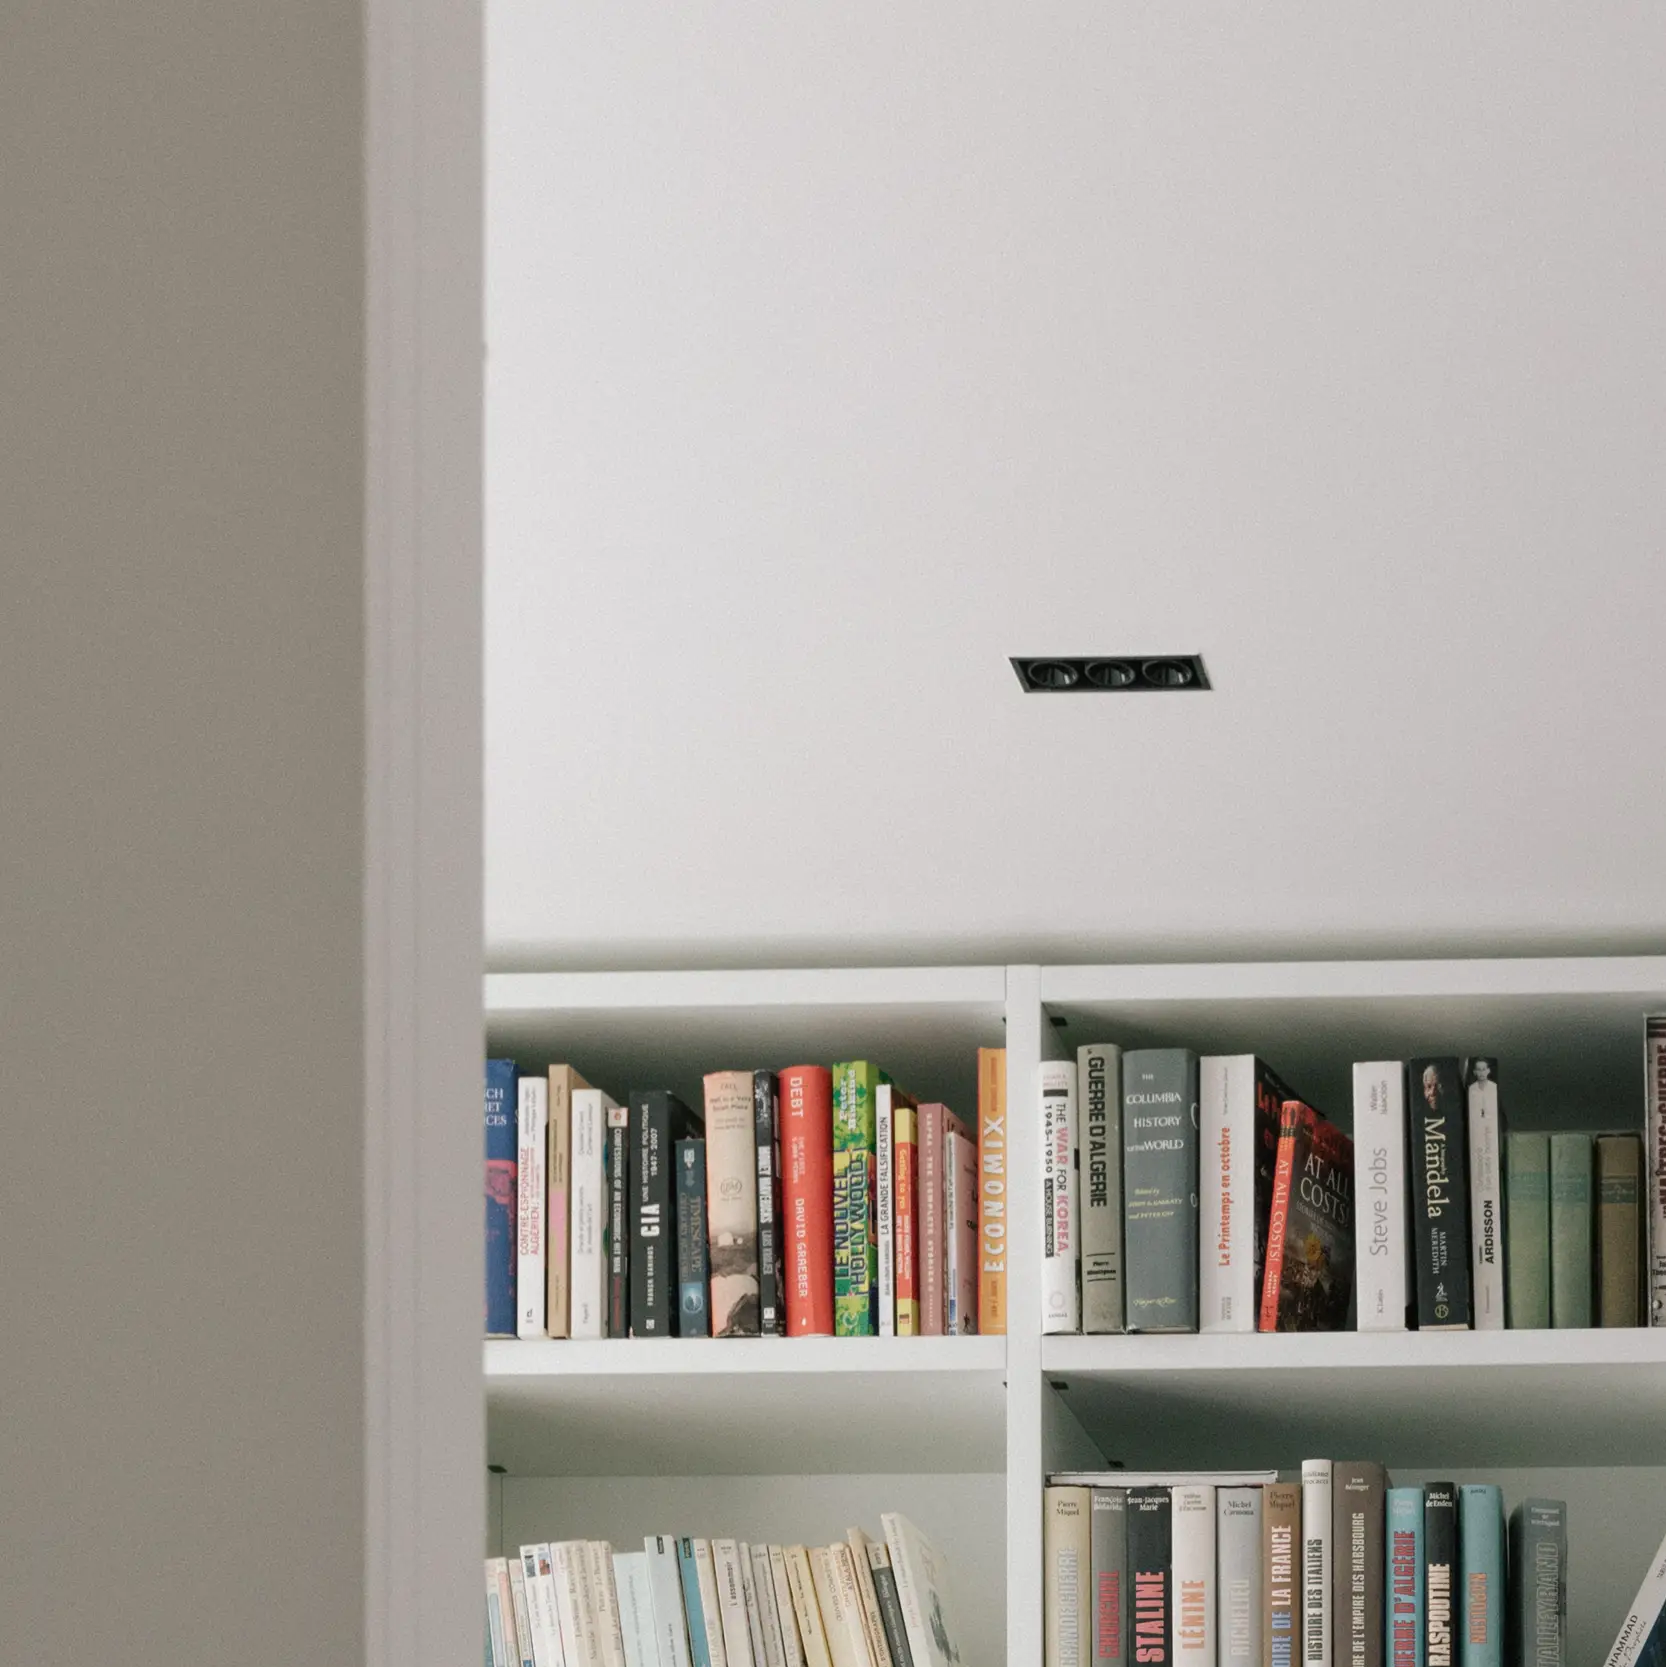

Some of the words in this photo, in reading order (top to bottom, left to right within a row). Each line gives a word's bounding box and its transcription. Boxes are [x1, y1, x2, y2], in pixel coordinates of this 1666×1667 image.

[790, 1076, 803, 1118] DEBT
[1088, 1056, 1105, 1123] GUERRE
[1126, 1094, 1183, 1105] COLUMBIA
[1056, 1103, 1068, 1123] THE
[1132, 1117, 1183, 1128] HISTORY
[880, 1116, 890, 1182] FALSIFICATION
[1045, 1104, 1054, 1174] 1945-1950
[1056, 1127, 1068, 1165] WAR
[1144, 1139, 1185, 1150] WORLD
[1218, 1126, 1230, 1171] octobre
[1055, 1169, 1068, 1192] FOR
[1088, 1126, 1107, 1207] D'ALGERIE
[1219, 1174, 1229, 1189] en
[1277, 1158, 1289, 1177] AT
[1304, 1152, 1323, 1177] AT
[1325, 1167, 1349, 1198] ALL
[1370, 1148, 1389, 1193] Jobs
[1424, 1116, 1449, 1219] Mandela
[880, 1184, 890, 1223] GRANDE
[983, 1115, 1005, 1273] ECONOMIX
[1274, 1182, 1287, 1206] ALL
[1299, 1176, 1349, 1227] COSTS!
[640, 1203, 660, 1237] CIA
[795, 1197, 806, 1239] DAVID
[880, 1225, 890, 1236] LA
[1055, 1195, 1069, 1257] KOREA,
[1217, 1191, 1231, 1251] Printemps
[1268, 1210, 1284, 1262] COSTS!
[1370, 1200, 1387, 1257] Steve
[1483, 1199, 1495, 1265] ARDISSON
[797, 1242, 808, 1299] GRAEBER
[1219, 1253, 1230, 1266] Le
[1272, 1524, 1292, 1582] FRANCE
[1393, 1530, 1416, 1615] D'ALGÉRIE
[1135, 1571, 1165, 1663] STALINE
[1179, 1580, 1206, 1649] LÉNINE
[1272, 1588, 1292, 1606] LA
[1428, 1563, 1451, 1667] RASPOUTINE
[1272, 1611, 1292, 1630] DE
